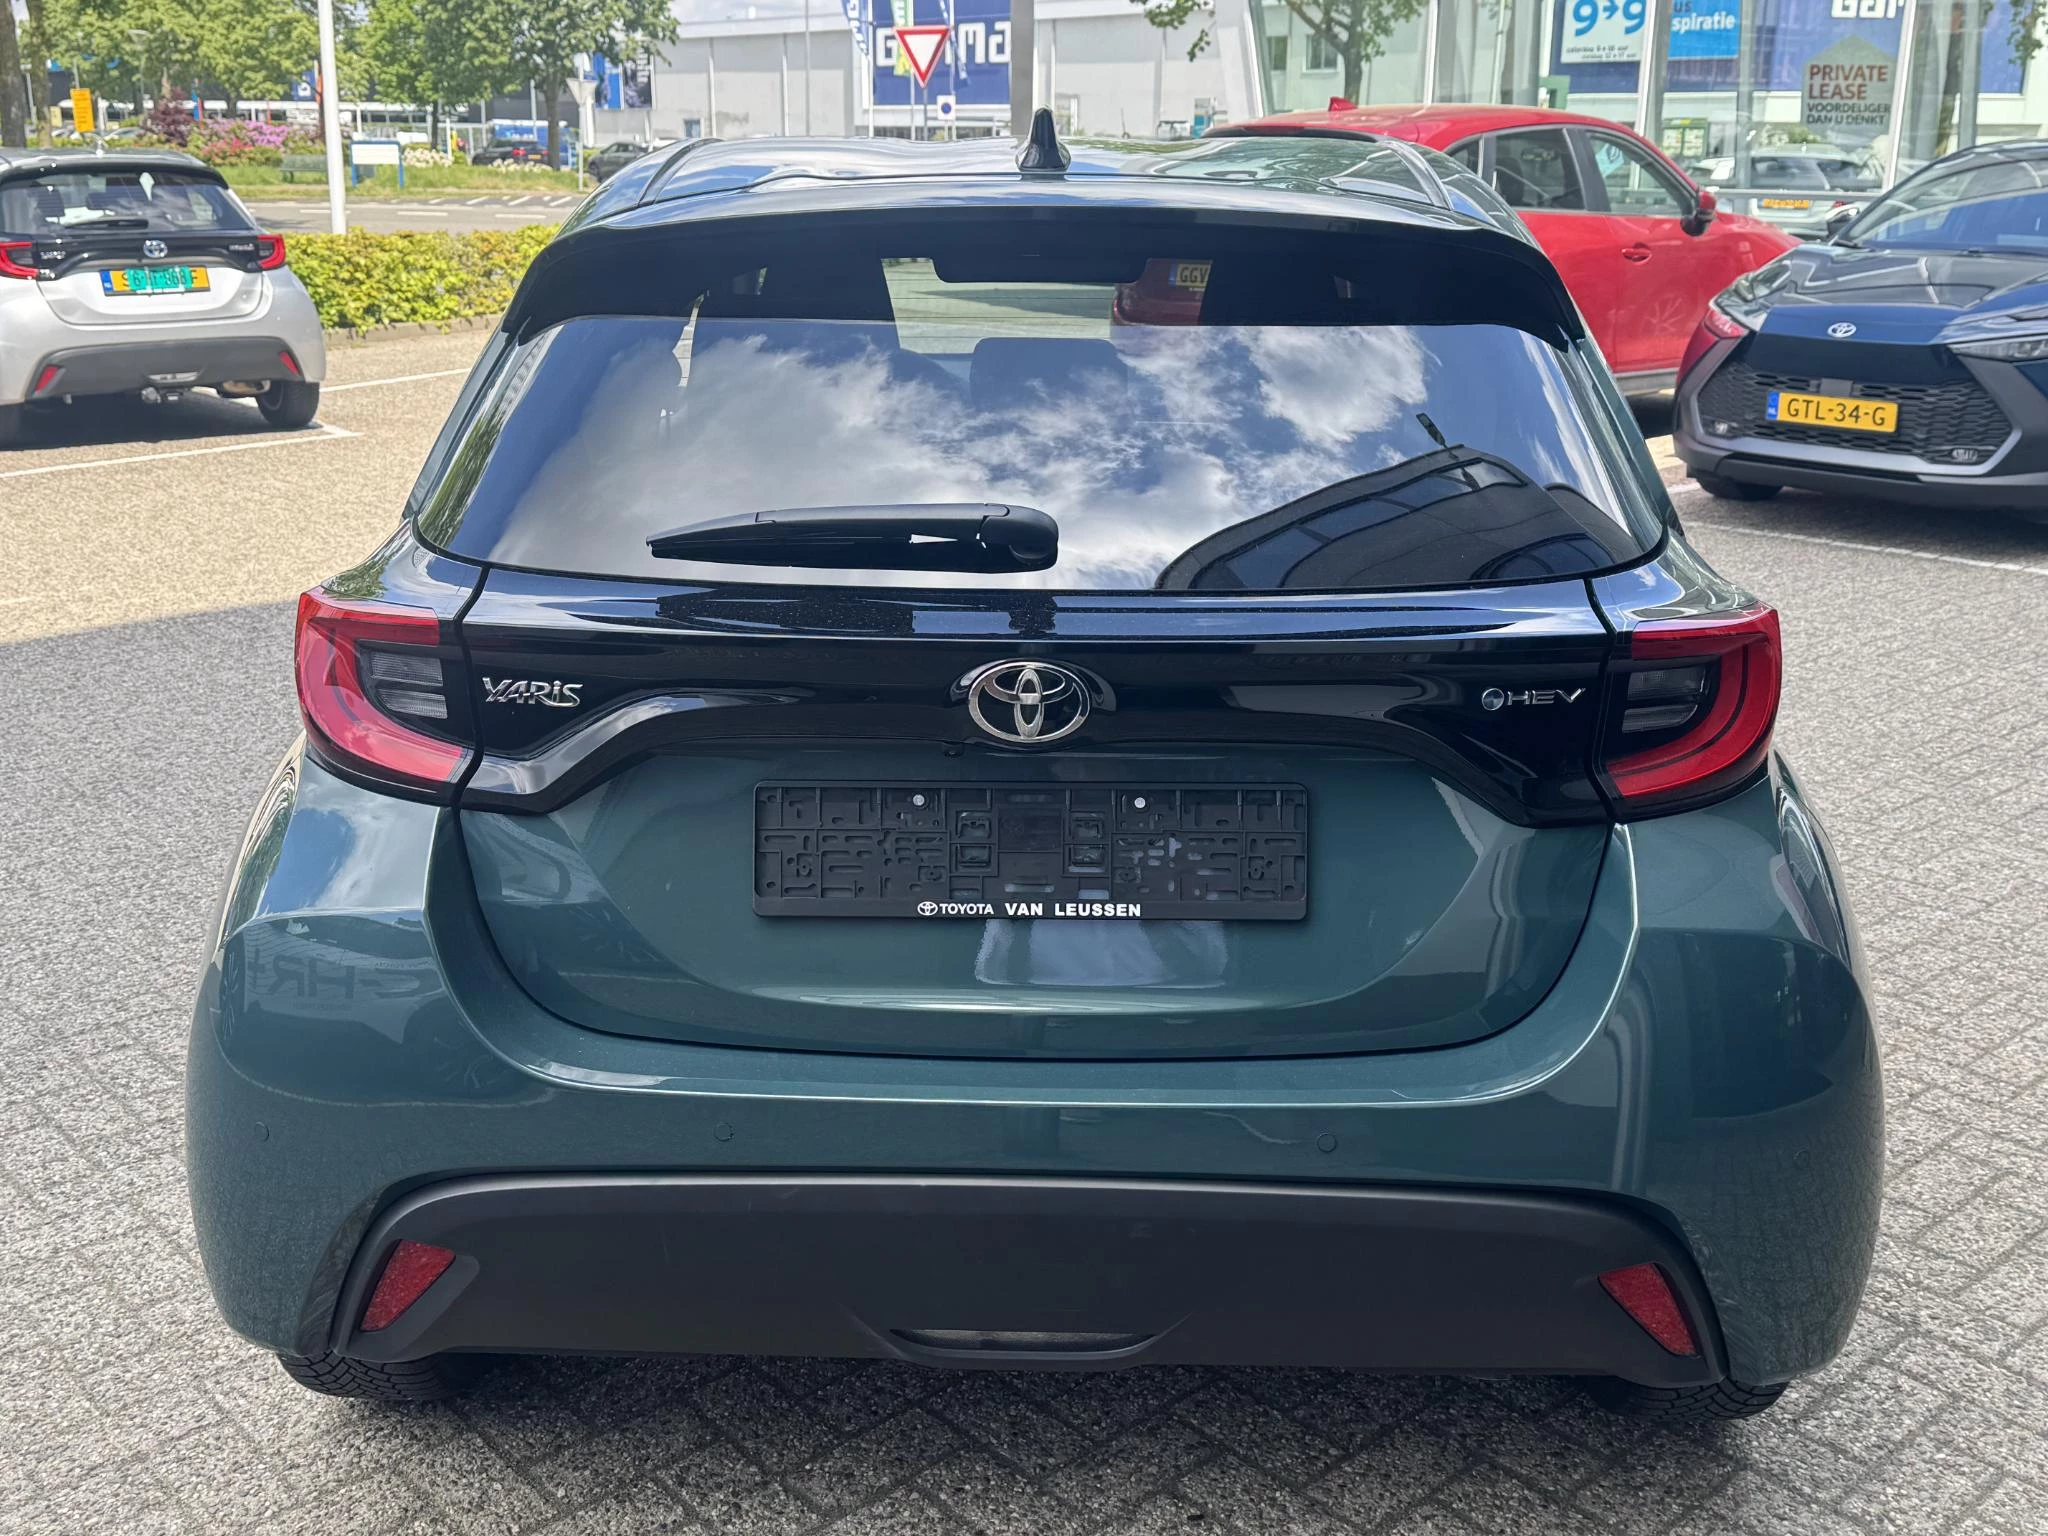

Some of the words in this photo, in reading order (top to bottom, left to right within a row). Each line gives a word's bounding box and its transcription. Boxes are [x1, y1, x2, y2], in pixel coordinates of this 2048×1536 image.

[1810, 64, 1888, 82] PRIVATE
[1808, 83, 1868, 100] LEASE
[1807, 114, 1833, 124] DAN
[1835, 115, 1844, 124] U
[1845, 114, 1886, 125] DENKT
[1786, 398, 1886, 427] GTL-34-G
[1507, 688, 1586, 706] HEV
[940, 903, 995, 915] TOYOTA
[1005, 902, 1043, 916] VAN
[1055, 903, 1141, 917] LEUSSEN
